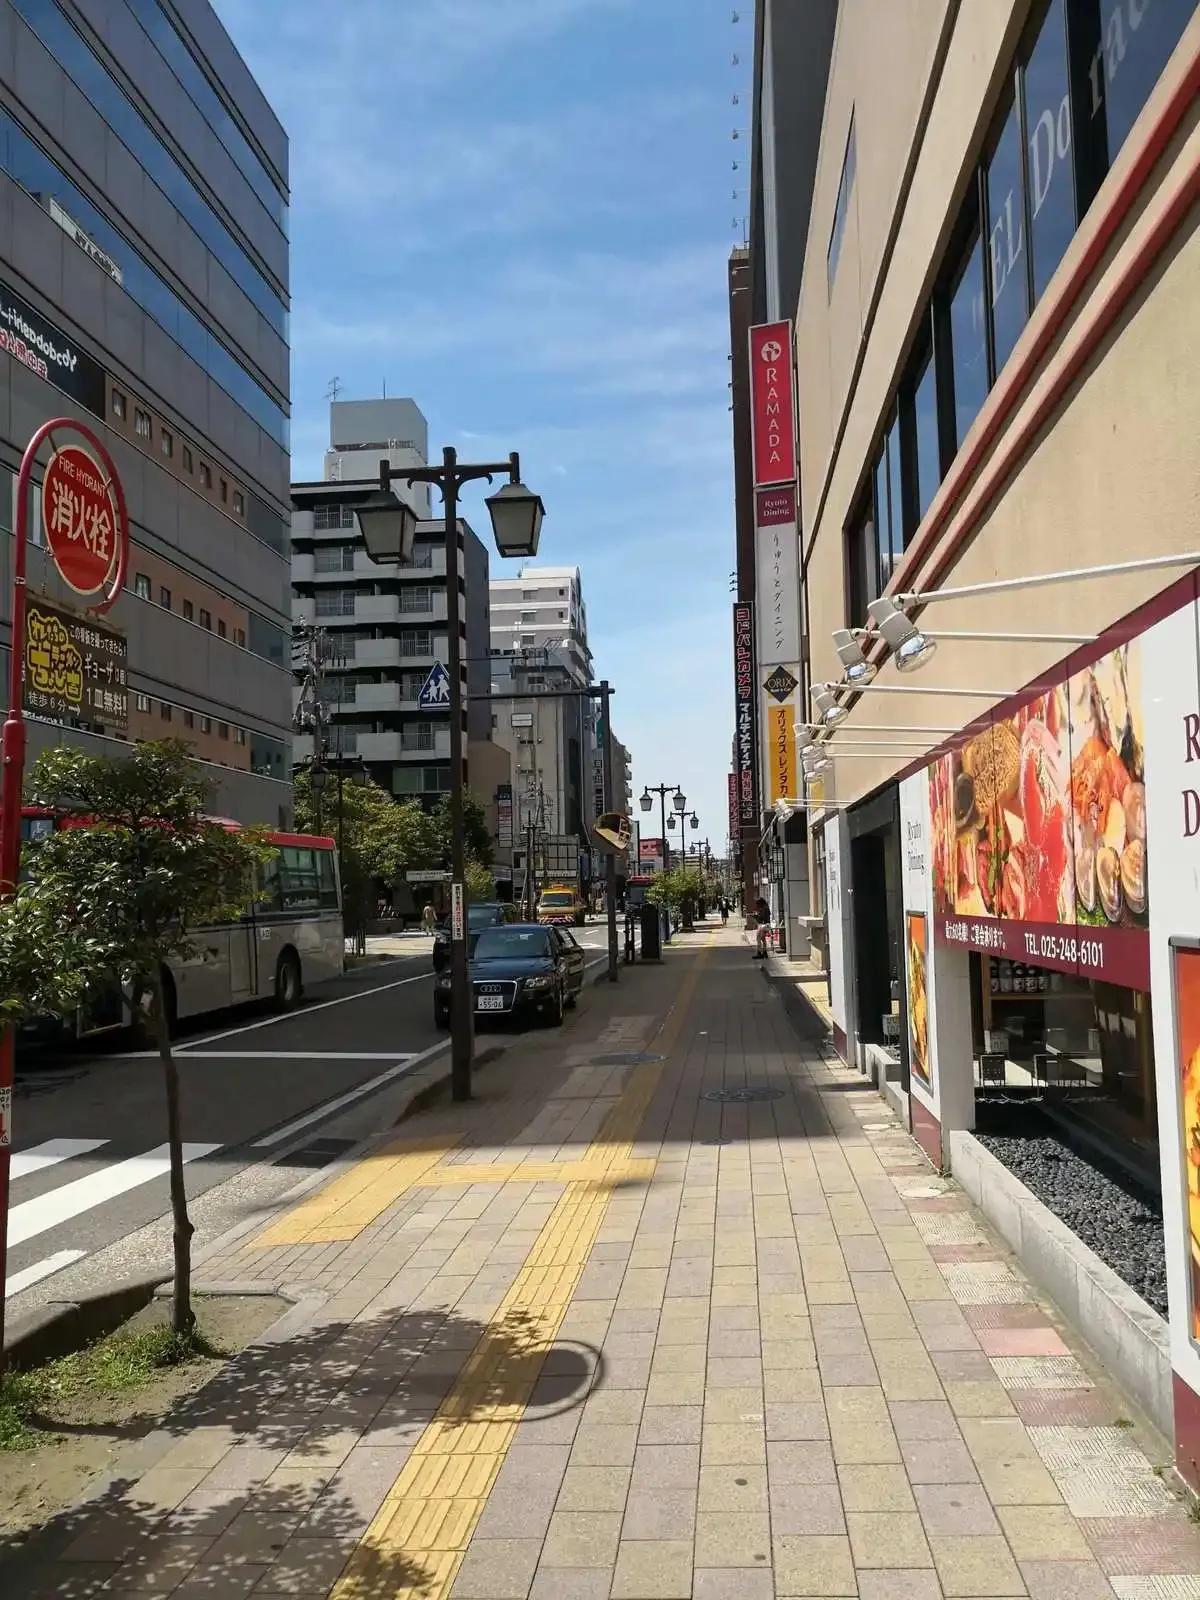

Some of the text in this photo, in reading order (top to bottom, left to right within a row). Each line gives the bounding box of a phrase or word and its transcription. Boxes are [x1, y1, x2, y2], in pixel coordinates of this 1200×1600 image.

[765, 367, 781, 464] RAMADA
[58, 456, 107, 498] FIRE HYDRANT
[51, 477, 112, 561] 消火栓
[763, 508, 790, 517] Dining
[767, 676, 793, 688] ORIX
[1041, 934, 1105, 969] 025-248-6101
